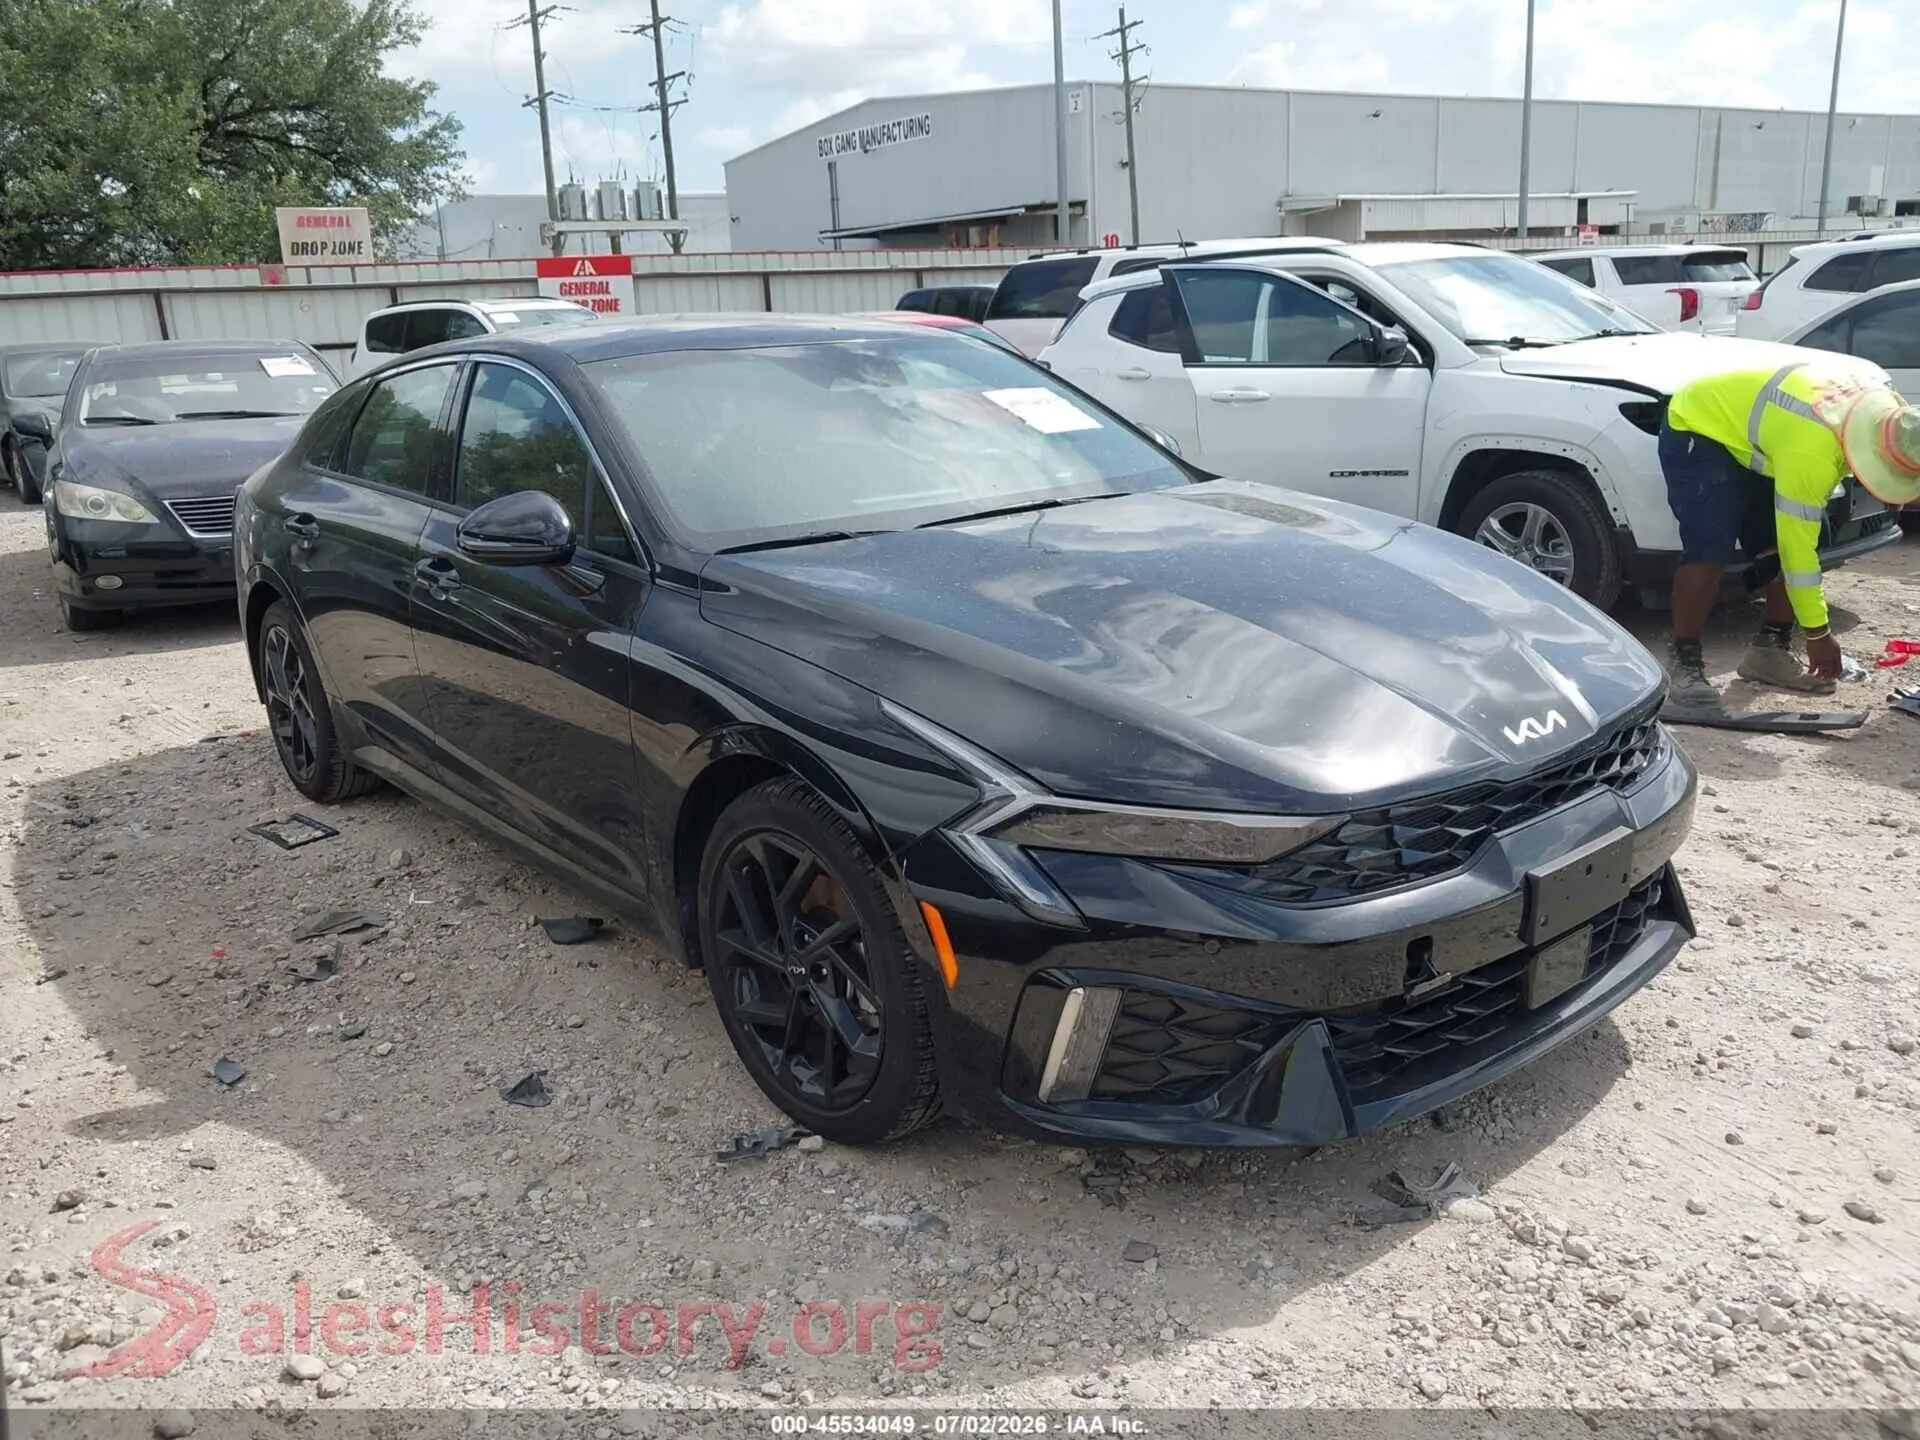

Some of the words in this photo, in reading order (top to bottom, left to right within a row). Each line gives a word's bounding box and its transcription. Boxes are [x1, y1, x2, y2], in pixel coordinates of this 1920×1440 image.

[818, 138, 834, 158] BOX
[834, 131, 857, 154] GANG
[858, 114, 931, 151] MANUFACTURING
[296, 214, 351, 229] GENERAL
[291, 241, 328, 256] DROP
[331, 240, 364, 256] ZONE
[559, 281, 611, 296] GENERAL
[591, 298, 621, 313] ZONE
